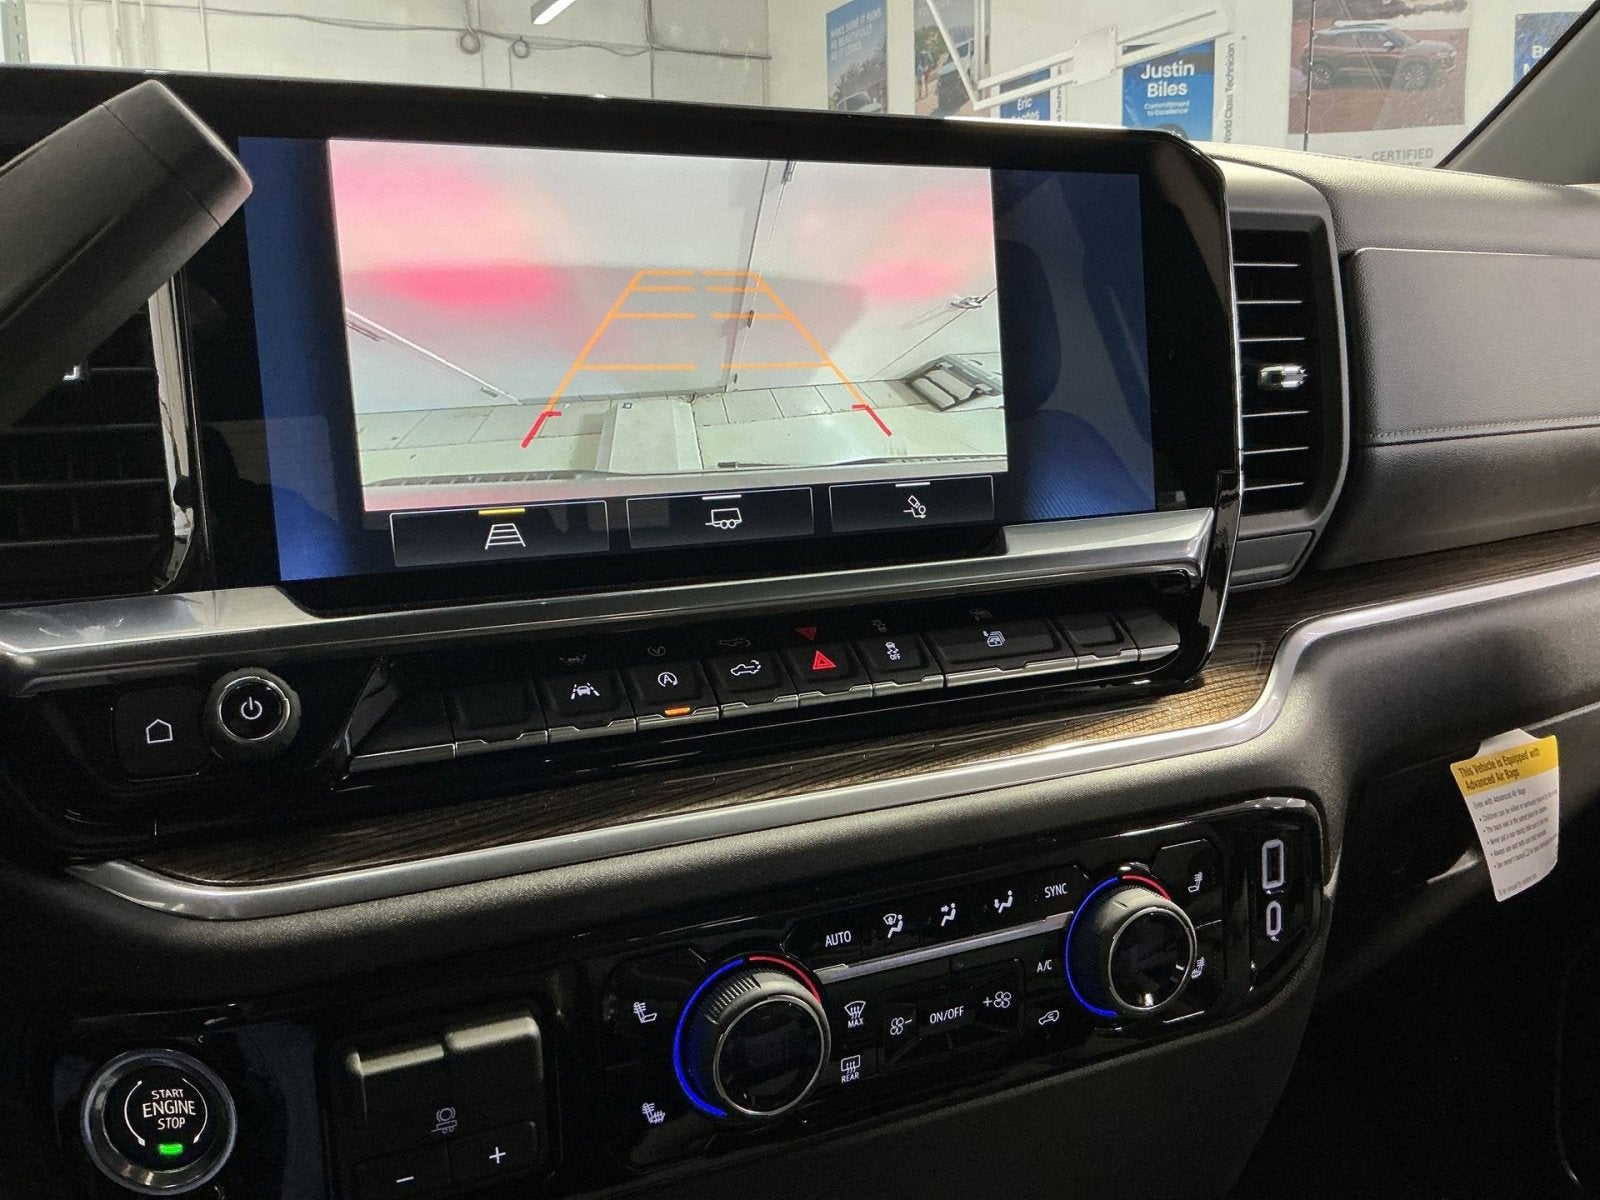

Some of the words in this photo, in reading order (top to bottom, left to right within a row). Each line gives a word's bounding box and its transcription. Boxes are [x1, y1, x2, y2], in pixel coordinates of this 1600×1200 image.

[1140, 60, 1195, 80] Justin
[1225, 43, 1235, 93] Technician
[1147, 81, 1188, 98] Biles
[1144, 101, 1191, 110] Commitment
[1224, 94, 1233, 118] Class
[1372, 147, 1434, 161] CERTIFIED
[1458, 766, 1474, 777] This
[1472, 760, 1496, 773] Vehicle
[1495, 757, 1503, 767] is
[1501, 750, 1529, 767] Equipped
[1465, 774, 1496, 791] Advanced
[1495, 772, 1505, 781] Air
[1504, 768, 1520, 779] Bags
[1044, 883, 1068, 898] SYNC
[825, 930, 852, 947] AUTO
[1036, 959, 1053, 973] A/C
[847, 1016, 865, 1028] MAX
[929, 1006, 965, 1024] ON/OFF
[841, 1071, 861, 1083] REAR
[151, 1088, 184, 1099] START
[142, 1100, 196, 1118] ENGINE
[157, 1117, 186, 1130] STOP
